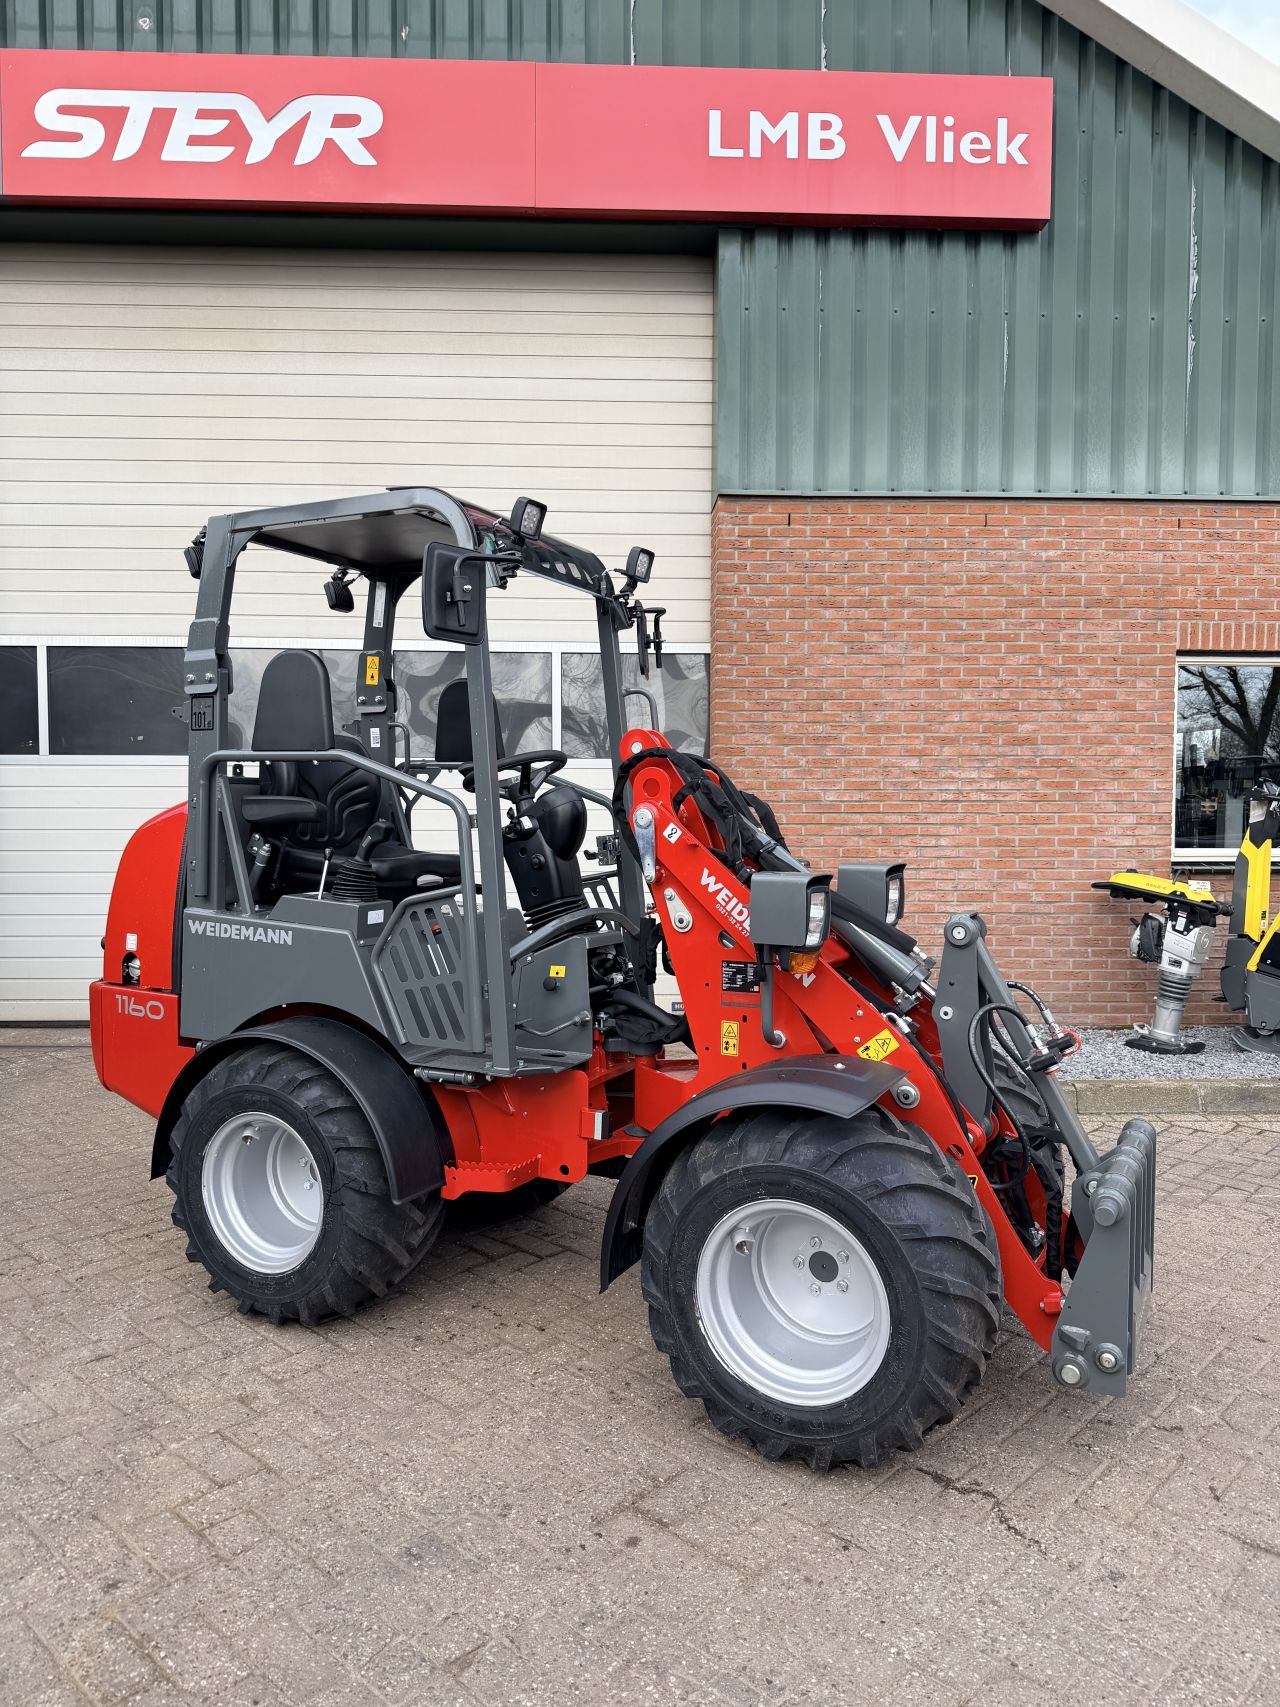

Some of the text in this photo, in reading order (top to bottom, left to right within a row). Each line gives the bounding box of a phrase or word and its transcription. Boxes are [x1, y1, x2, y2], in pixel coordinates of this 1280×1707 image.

[20, 88, 384, 166] STEYR
[708, 109, 1029, 165] LMB Vliek
[188, 919, 293, 946] WEIDEMANN
[115, 994, 165, 1020] 1160
